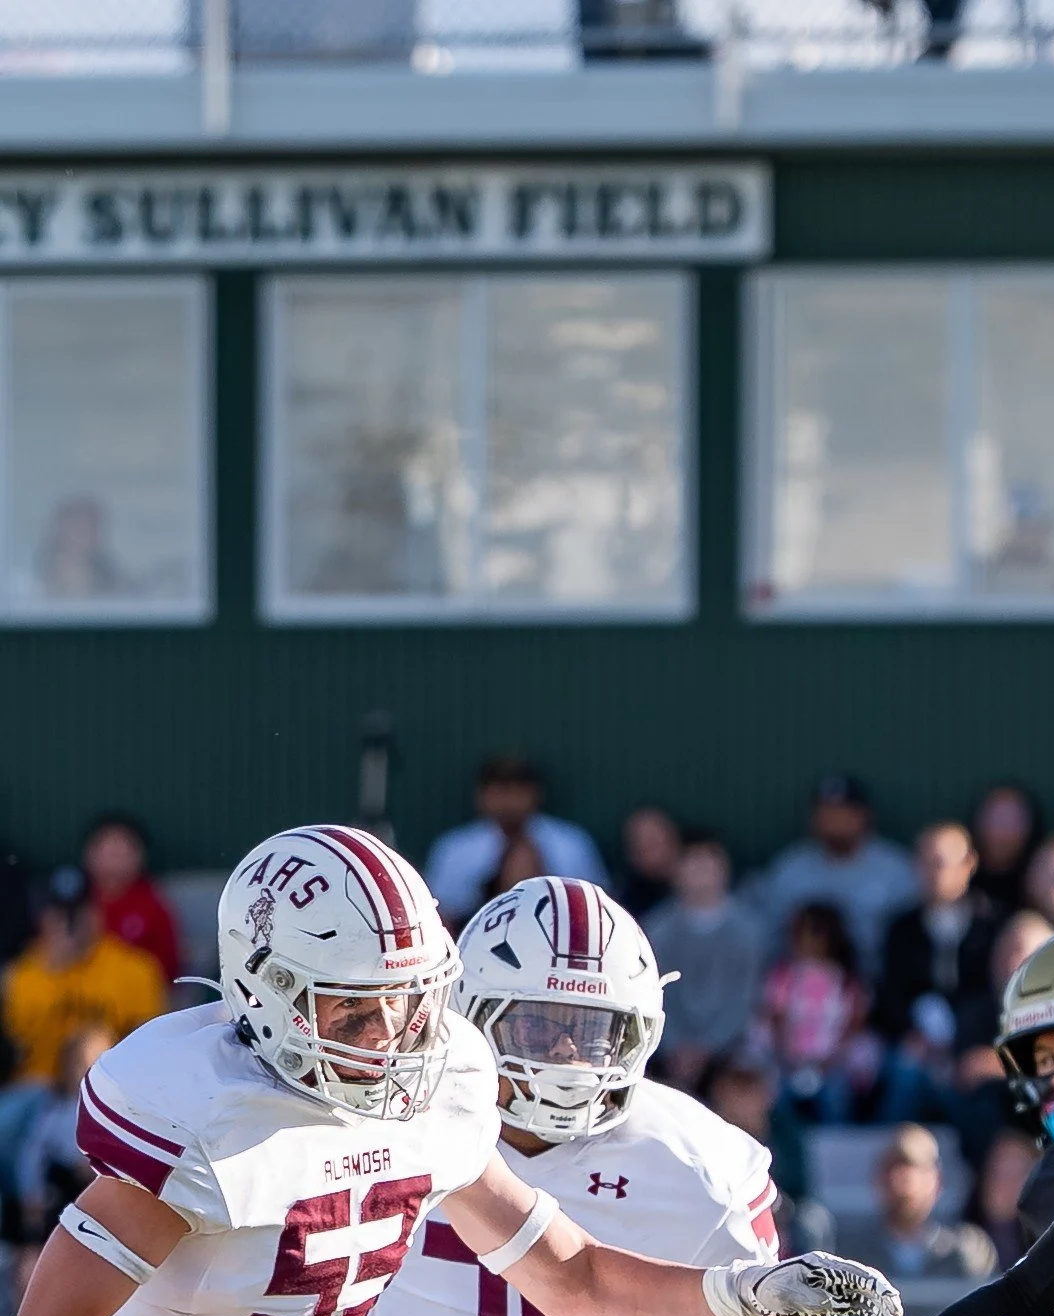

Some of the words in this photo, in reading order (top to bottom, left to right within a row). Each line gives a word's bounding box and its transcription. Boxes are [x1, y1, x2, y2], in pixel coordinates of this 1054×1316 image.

[0, 182, 50, 243] Y
[82, 181, 479, 241] SULLIVAN
[508, 179, 745, 238] FIELD
[247, 852, 330, 909] AHS
[546, 976, 607, 995] Riddell
[323, 1148, 392, 1184] ALAMOSA
